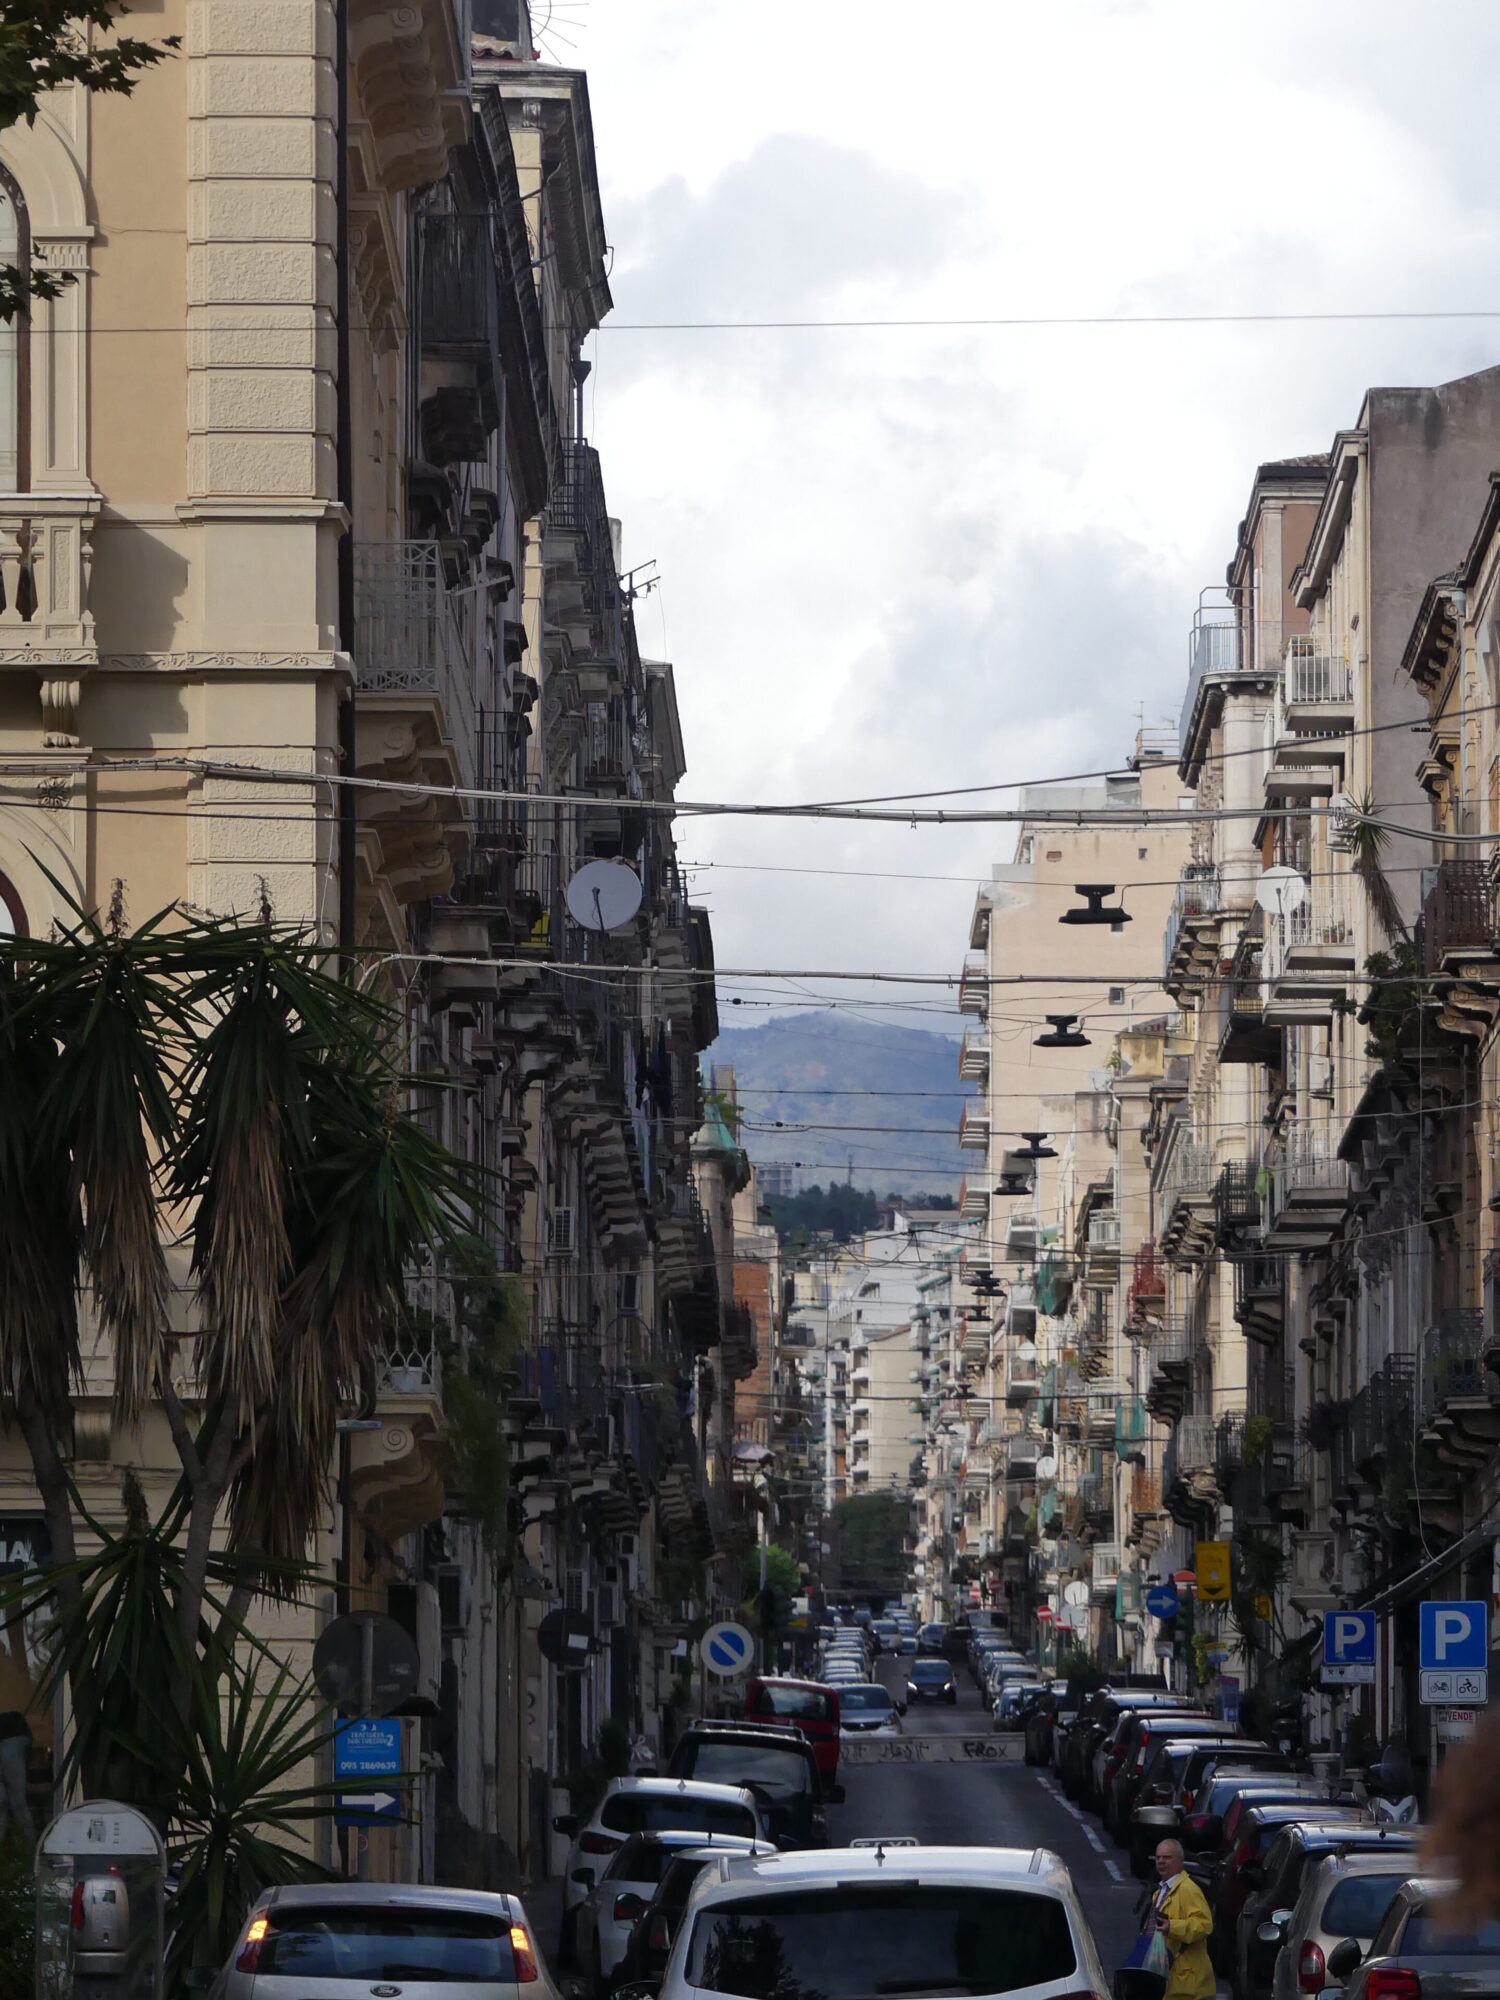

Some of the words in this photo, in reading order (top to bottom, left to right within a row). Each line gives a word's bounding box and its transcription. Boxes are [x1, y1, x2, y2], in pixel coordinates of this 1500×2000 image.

[1334, 1615, 1366, 1659] P
[1435, 1610, 1471, 1660] P
[1448, 1711, 1473, 1721] VENDE
